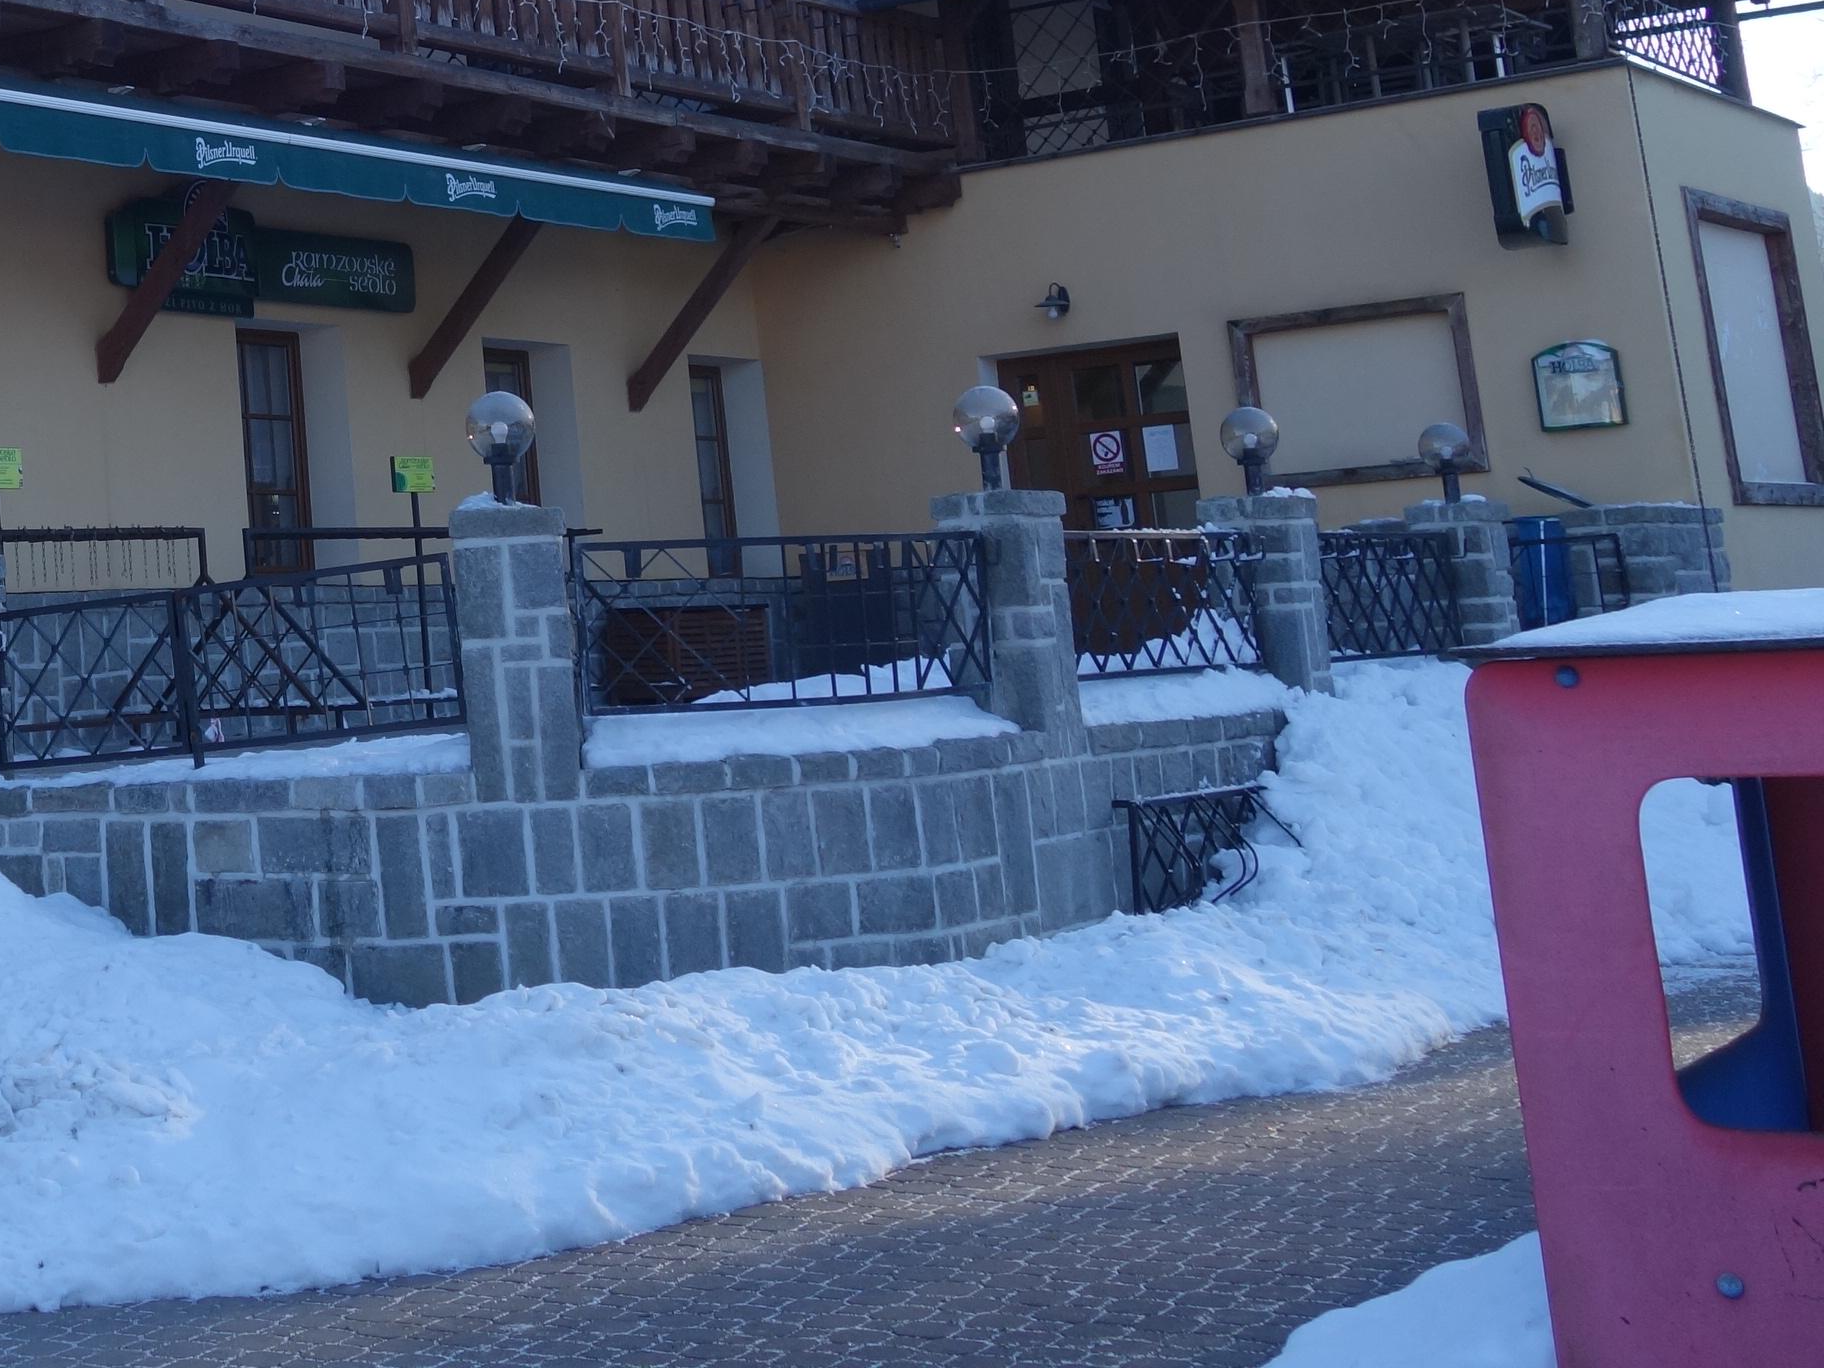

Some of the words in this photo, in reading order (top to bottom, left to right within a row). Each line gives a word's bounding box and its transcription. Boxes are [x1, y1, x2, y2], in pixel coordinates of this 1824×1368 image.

[196, 137, 225, 169] Pilsner
[224, 140, 256, 165] Urquell
[446, 173, 472, 202] Pilsner
[469, 175, 496, 198] Urquell
[1520, 154, 1550, 197] Pilsner
[653, 204, 676, 231] Pilsner
[674, 204, 697, 226] Urquell
[291, 251, 396, 277] Ramzovské
[281, 263, 325, 288] Chata
[349, 273, 396, 296] sedlo
